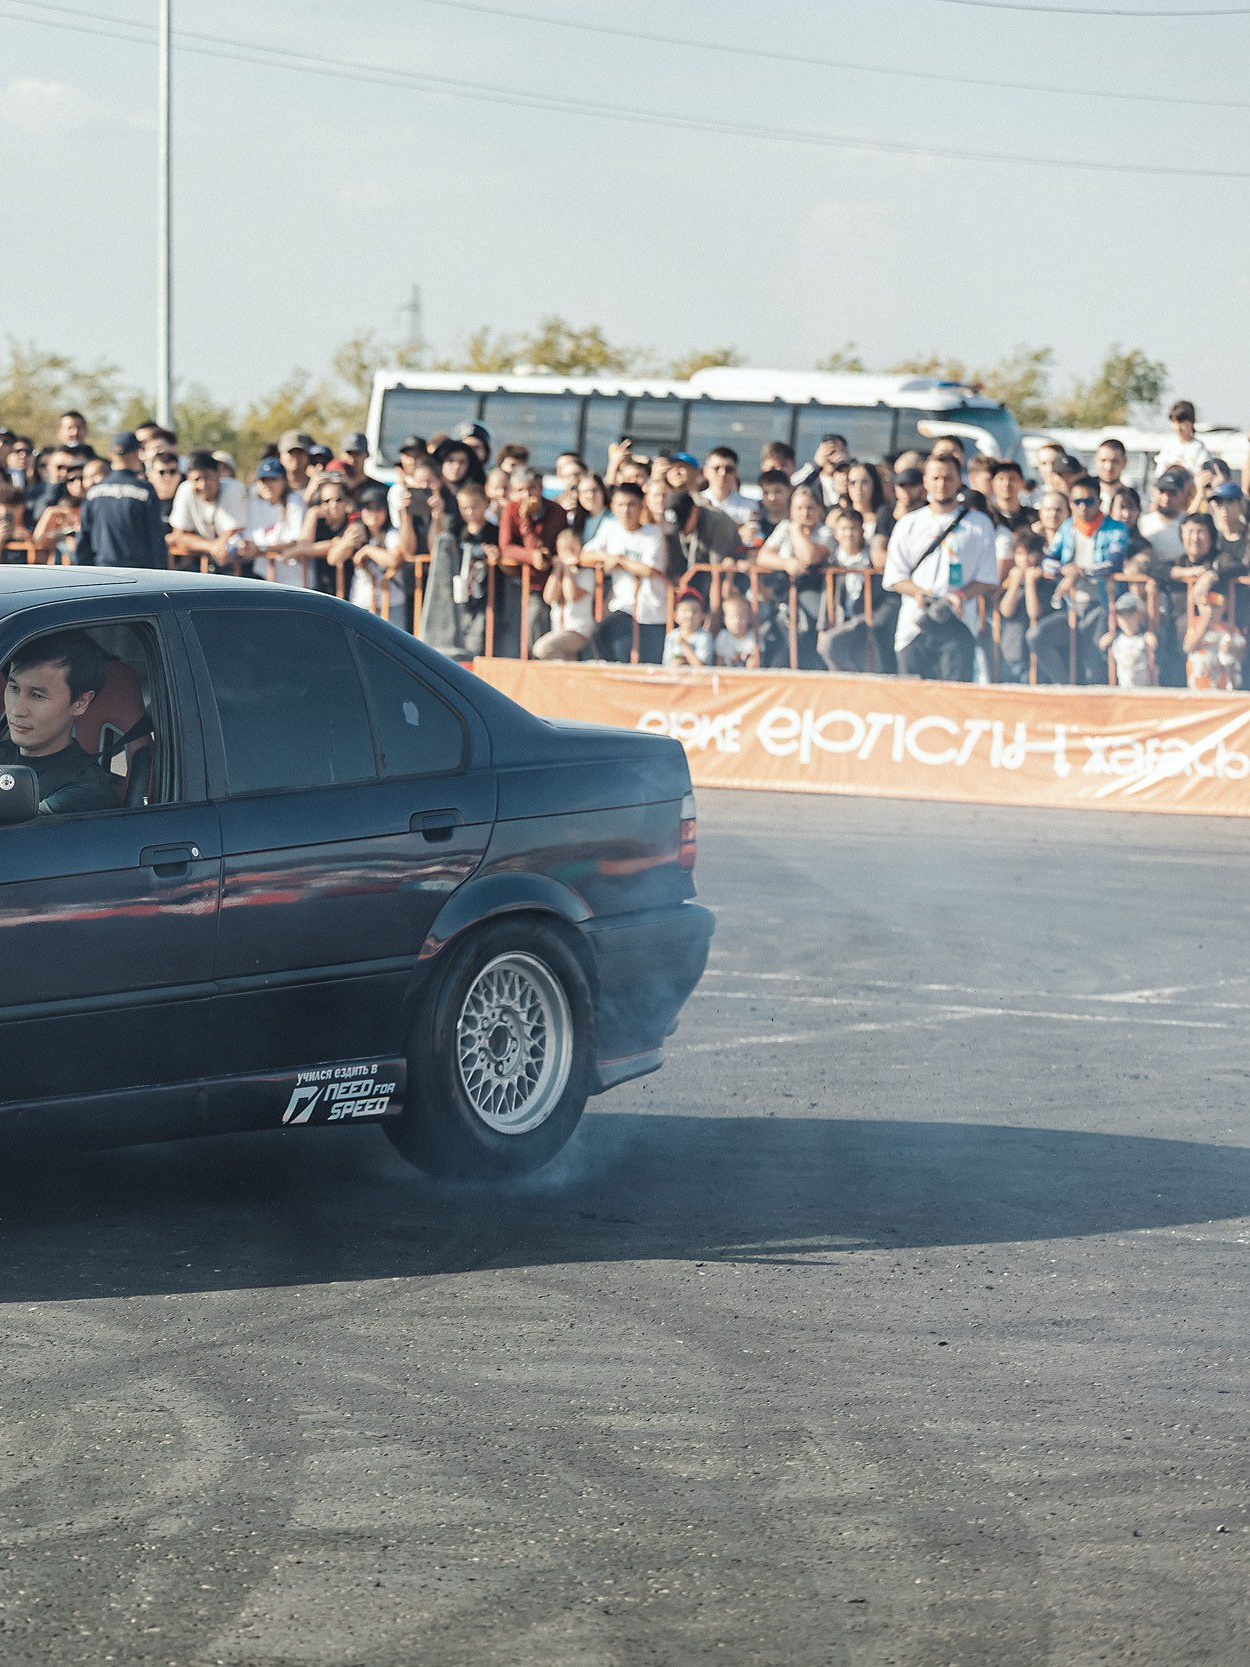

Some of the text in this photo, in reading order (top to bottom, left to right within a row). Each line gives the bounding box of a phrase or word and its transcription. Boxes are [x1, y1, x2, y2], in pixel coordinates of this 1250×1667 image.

[323, 1079, 396, 1101] NEED FOR
[327, 1097, 390, 1120] SPEED
